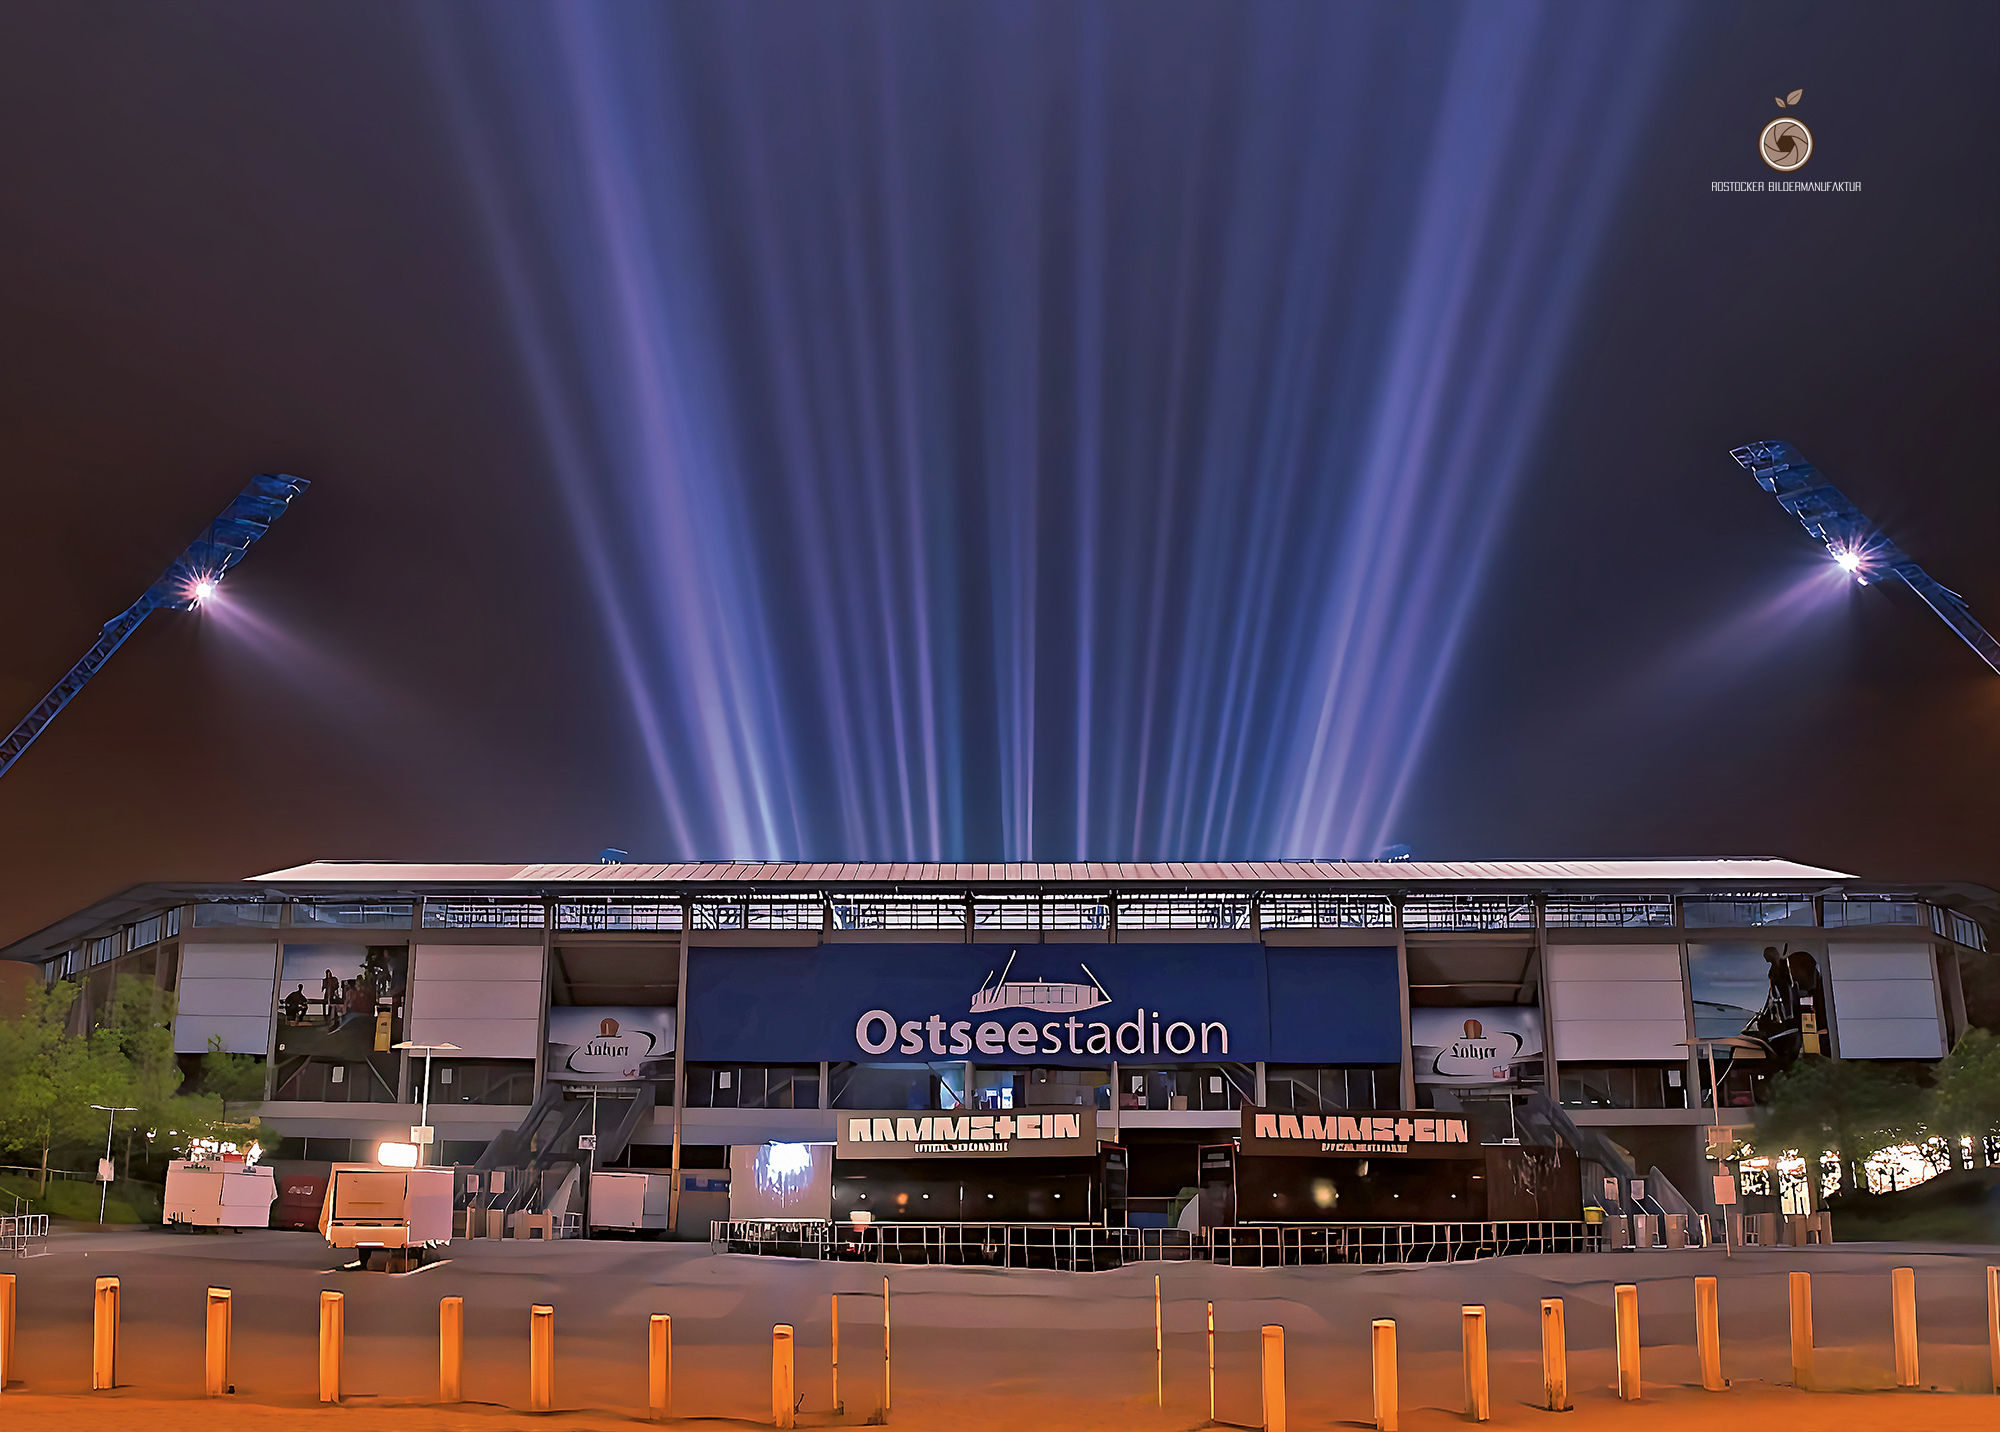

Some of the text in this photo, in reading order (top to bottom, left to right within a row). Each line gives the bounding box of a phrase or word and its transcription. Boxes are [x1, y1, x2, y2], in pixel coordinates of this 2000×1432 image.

[855, 1008, 1229, 1055] Ostseestadion
[849, 1114, 1080, 1142] RAMMSTEIN
[1255, 1114, 1469, 1143] RAMMSTEIN
